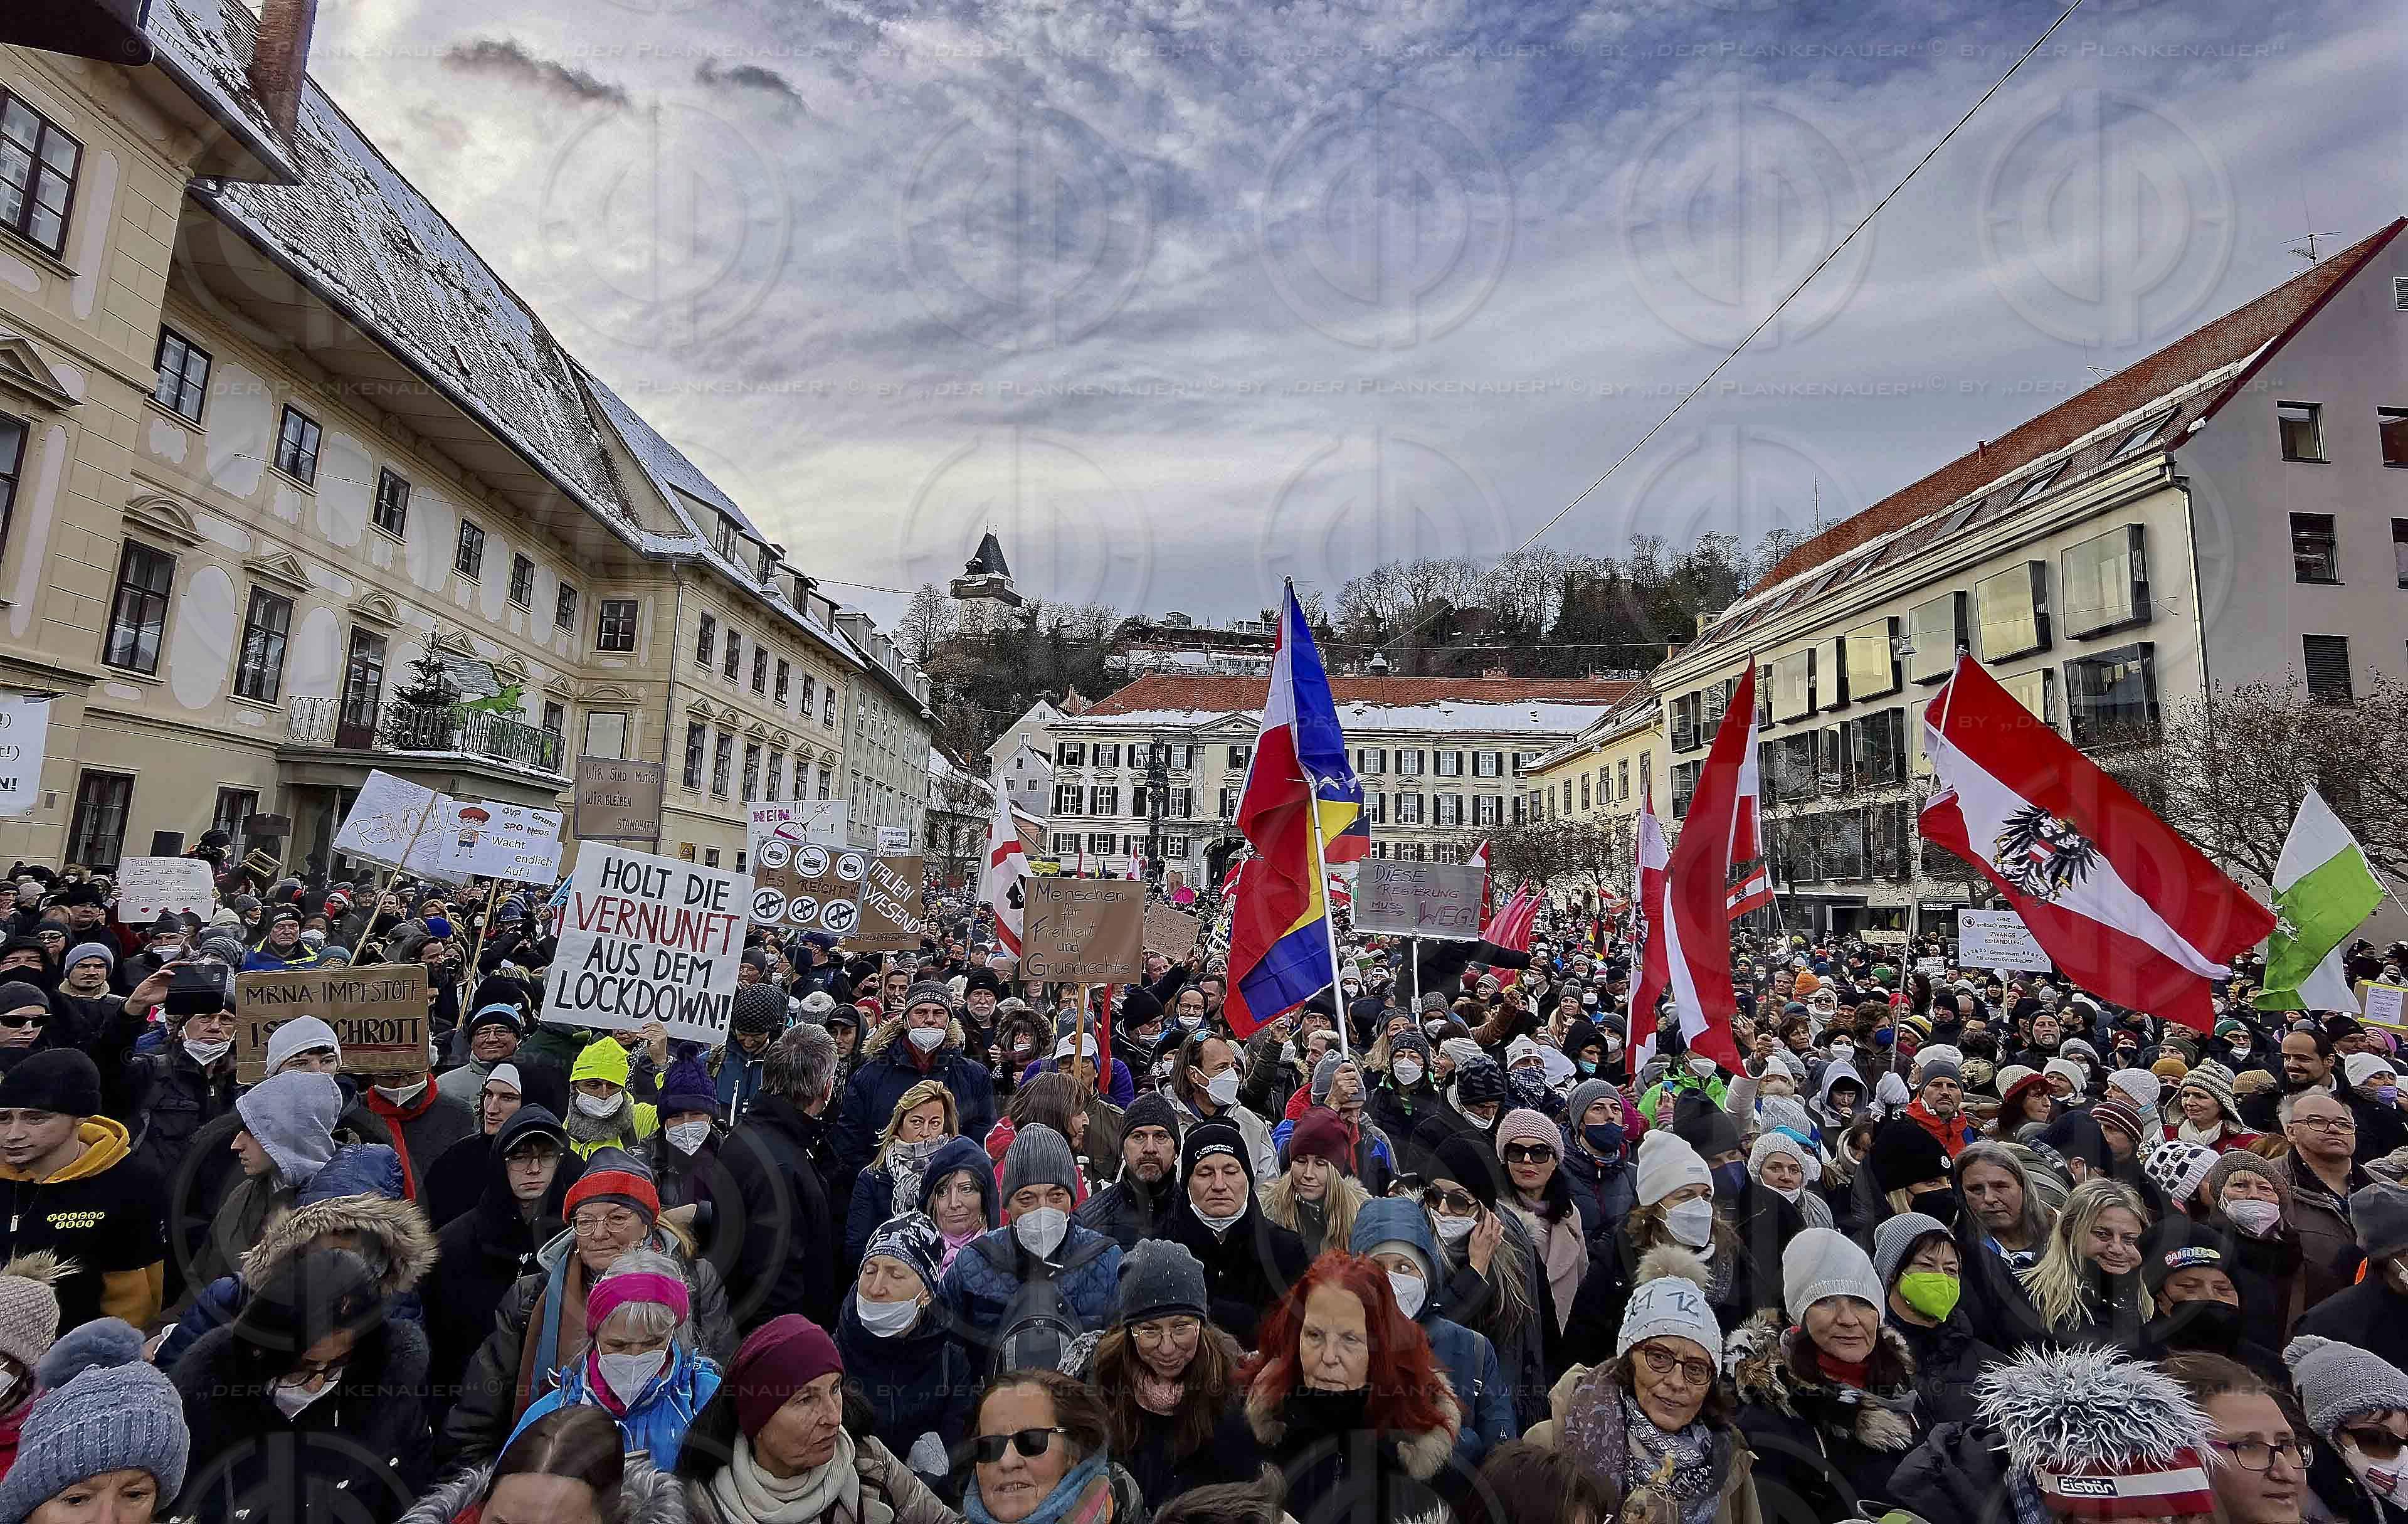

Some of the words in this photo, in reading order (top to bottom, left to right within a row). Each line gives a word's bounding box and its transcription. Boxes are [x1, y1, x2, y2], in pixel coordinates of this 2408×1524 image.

[492, 836, 526, 849] Wacht
[515, 855, 552, 867] endlich
[600, 857, 672, 900] HOLT
[684, 874, 731, 911] DIE
[764, 868, 786, 888] ES
[1034, 880, 1127, 903] Menschen
[863, 881, 921, 934] WESEND
[1061, 902, 1082, 921] für
[1371, 901, 1403, 909] MUSS
[1418, 898, 1481, 927] WEG!
[575, 892, 741, 956] VERNUNFT
[1030, 915, 1097, 943] Freiheit
[1057, 939, 1080, 952] und
[583, 936, 643, 976] AUS
[653, 949, 713, 989] DEM
[1026, 952, 1131, 977] Grundrechte
[554, 970, 732, 1032] LOCKDOWN!
[326, 1017, 421, 1045] CHROTT
[2061, 1478, 2114, 1494] Eisbär
